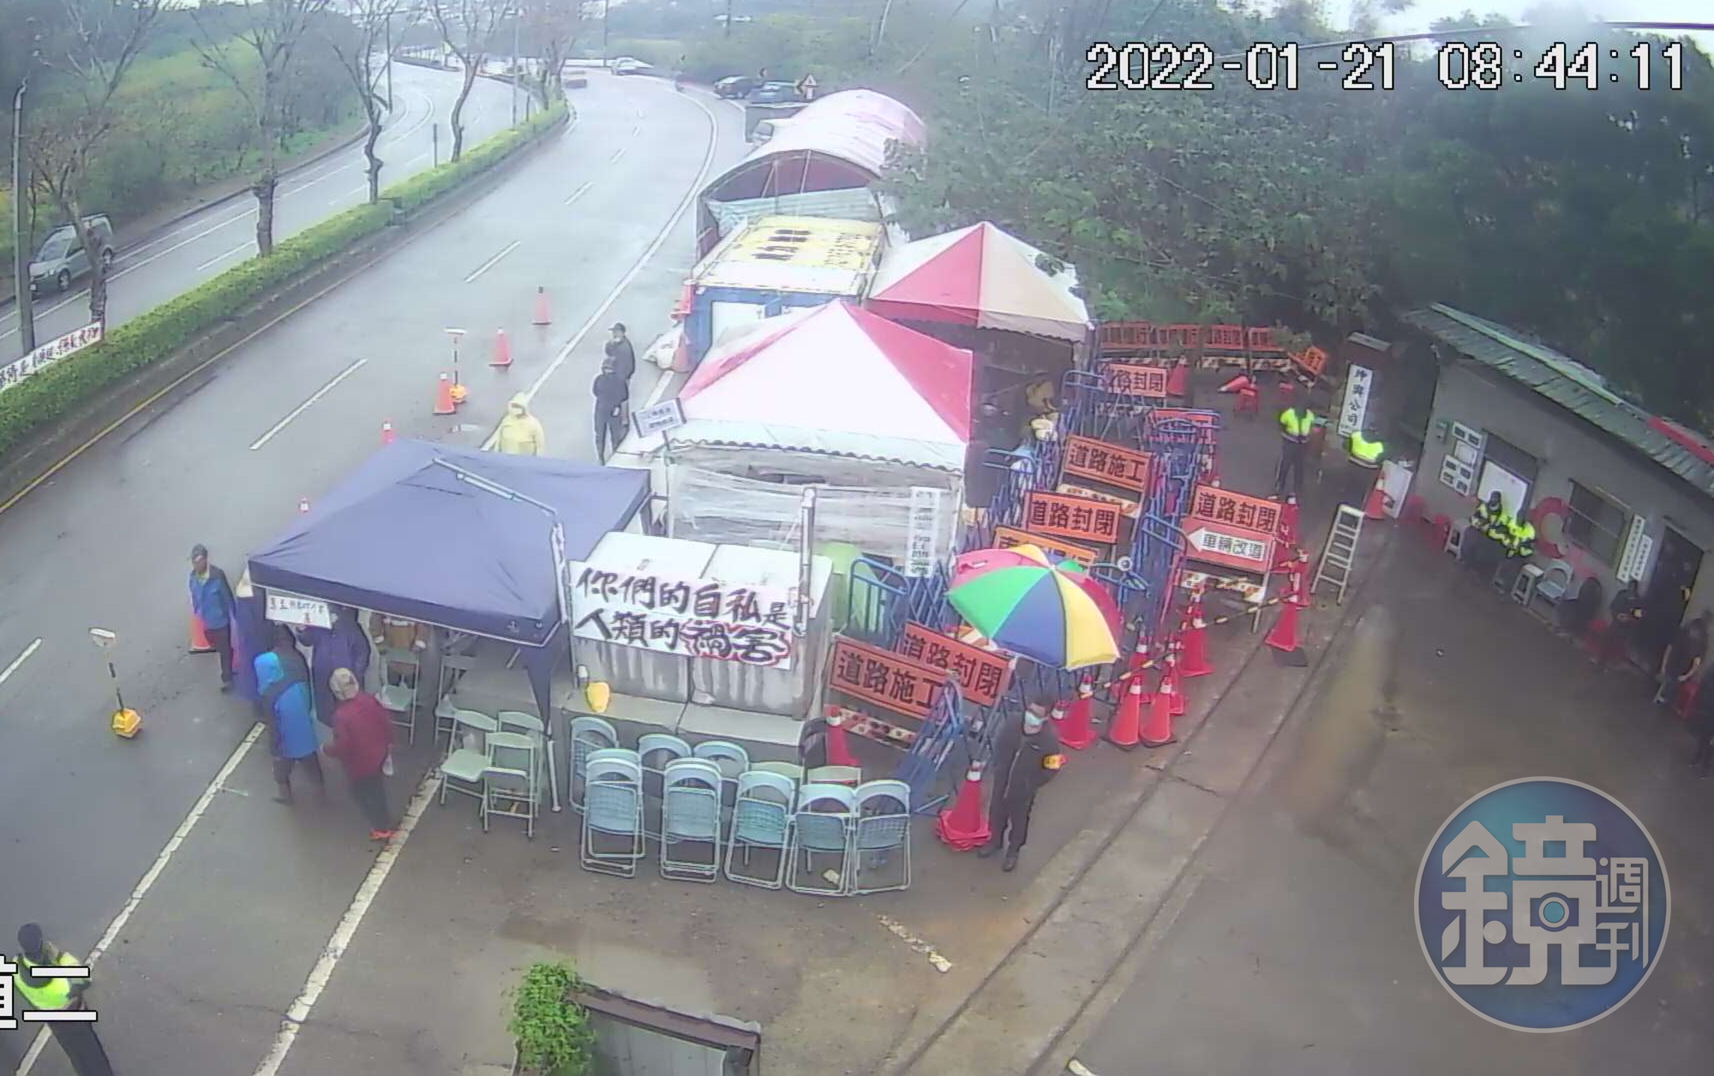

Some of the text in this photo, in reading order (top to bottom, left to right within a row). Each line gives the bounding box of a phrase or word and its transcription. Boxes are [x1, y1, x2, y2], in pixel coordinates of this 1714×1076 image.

[1069, 443, 1146, 482] 道路施工
[1196, 492, 1276, 532] 道路封閉
[576, 567, 791, 630] 你們的自私是
[575, 607, 790, 666] 人類的禍害
[904, 632, 1003, 699] 道路封閉
[838, 650, 945, 709] 道路施工
